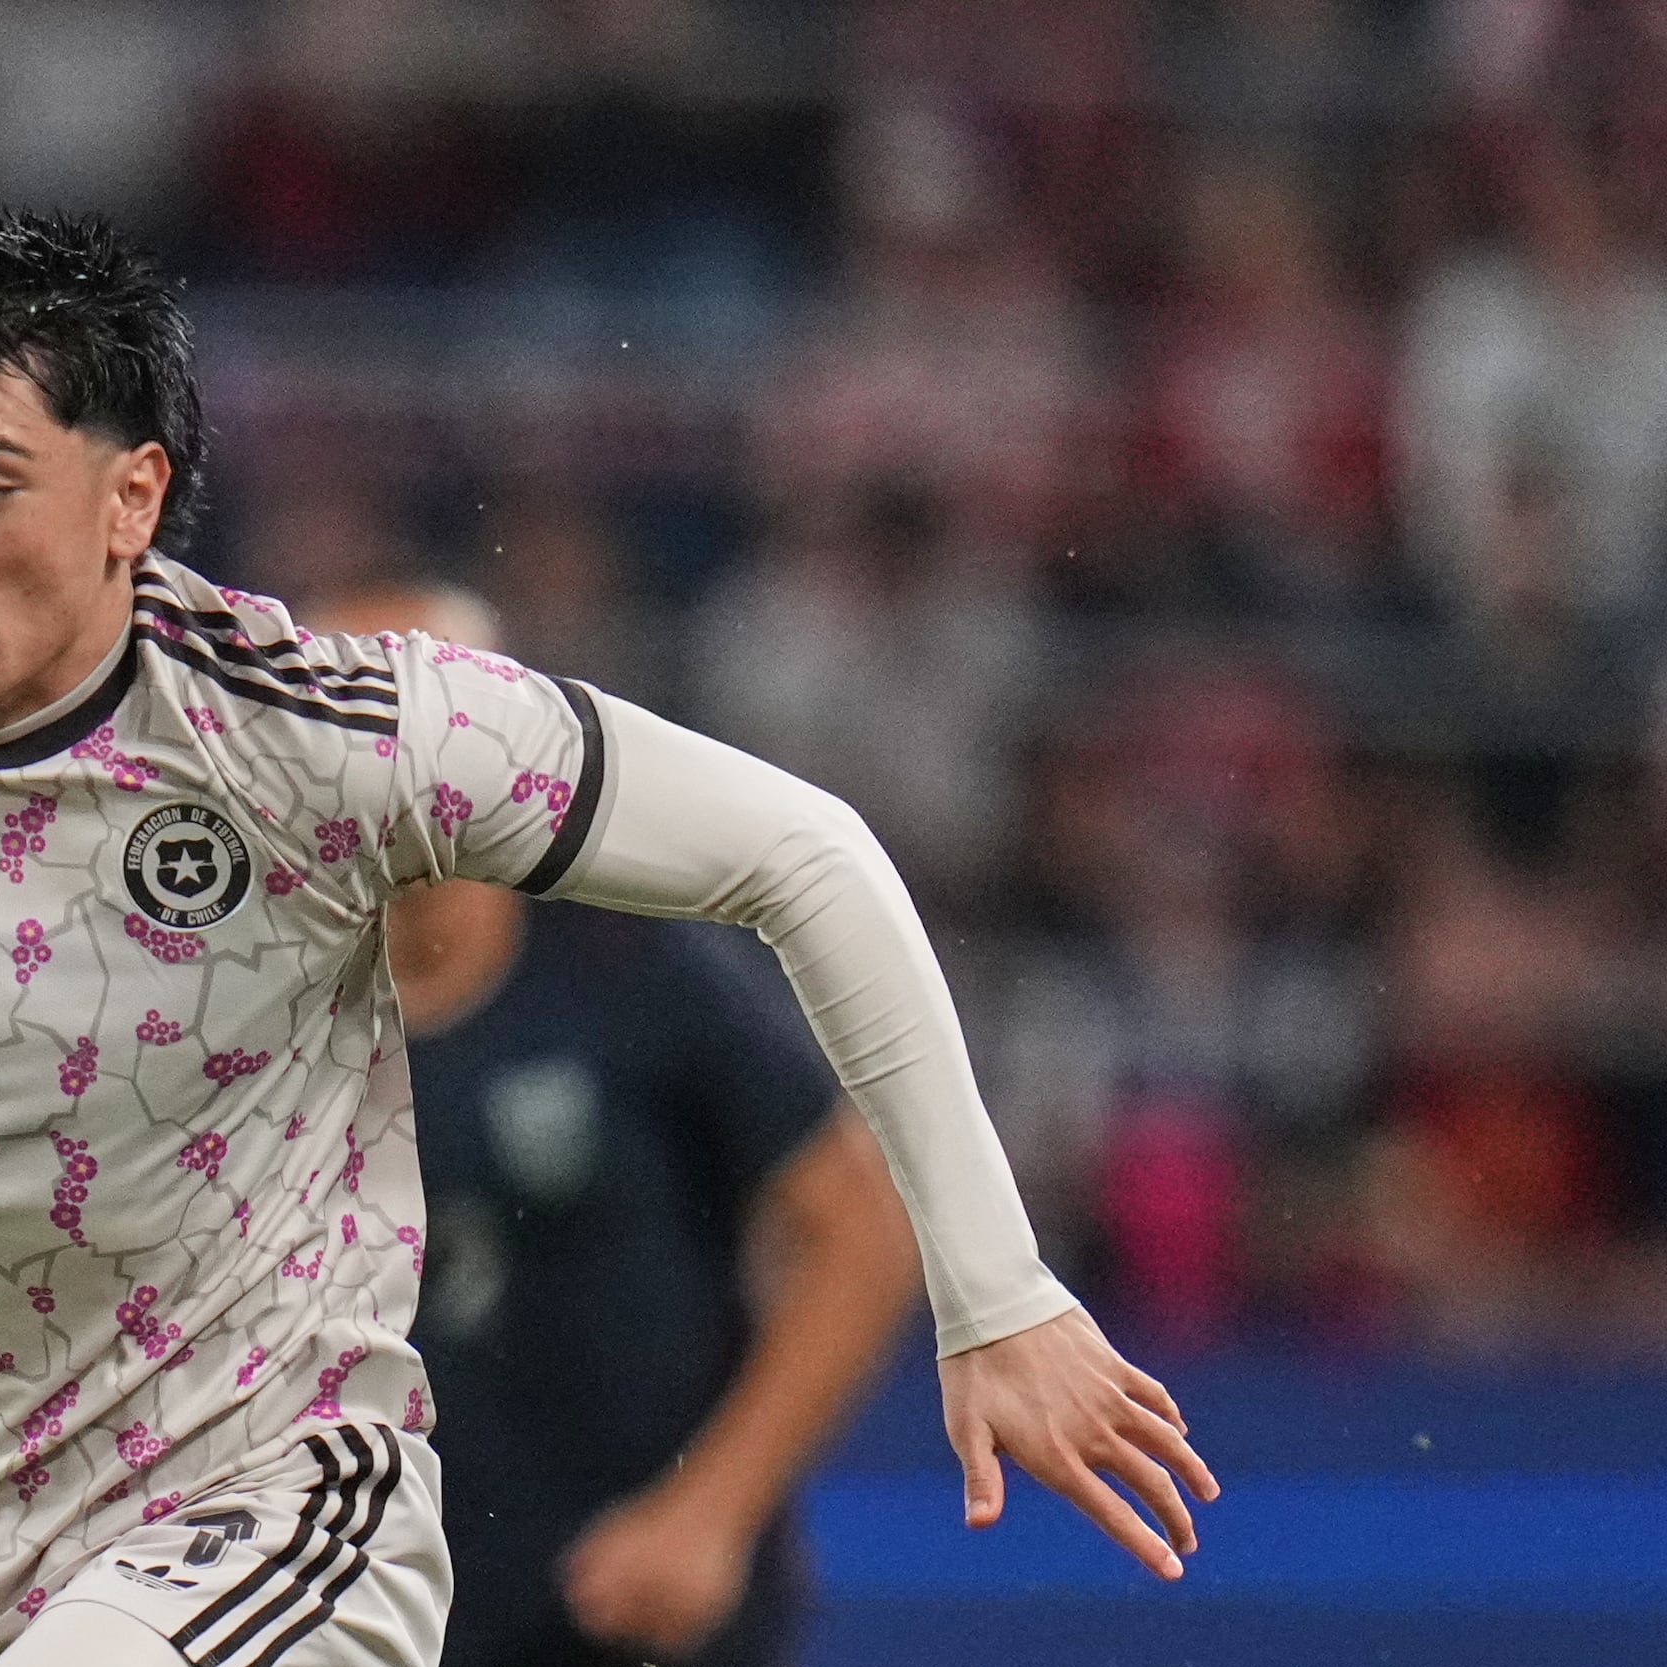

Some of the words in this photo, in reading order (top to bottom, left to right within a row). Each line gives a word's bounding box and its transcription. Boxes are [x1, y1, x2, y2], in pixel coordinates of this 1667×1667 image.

[190, 807, 208, 826] DE
[160, 908, 179, 924] DE
[187, 901, 224, 925] CHILE
